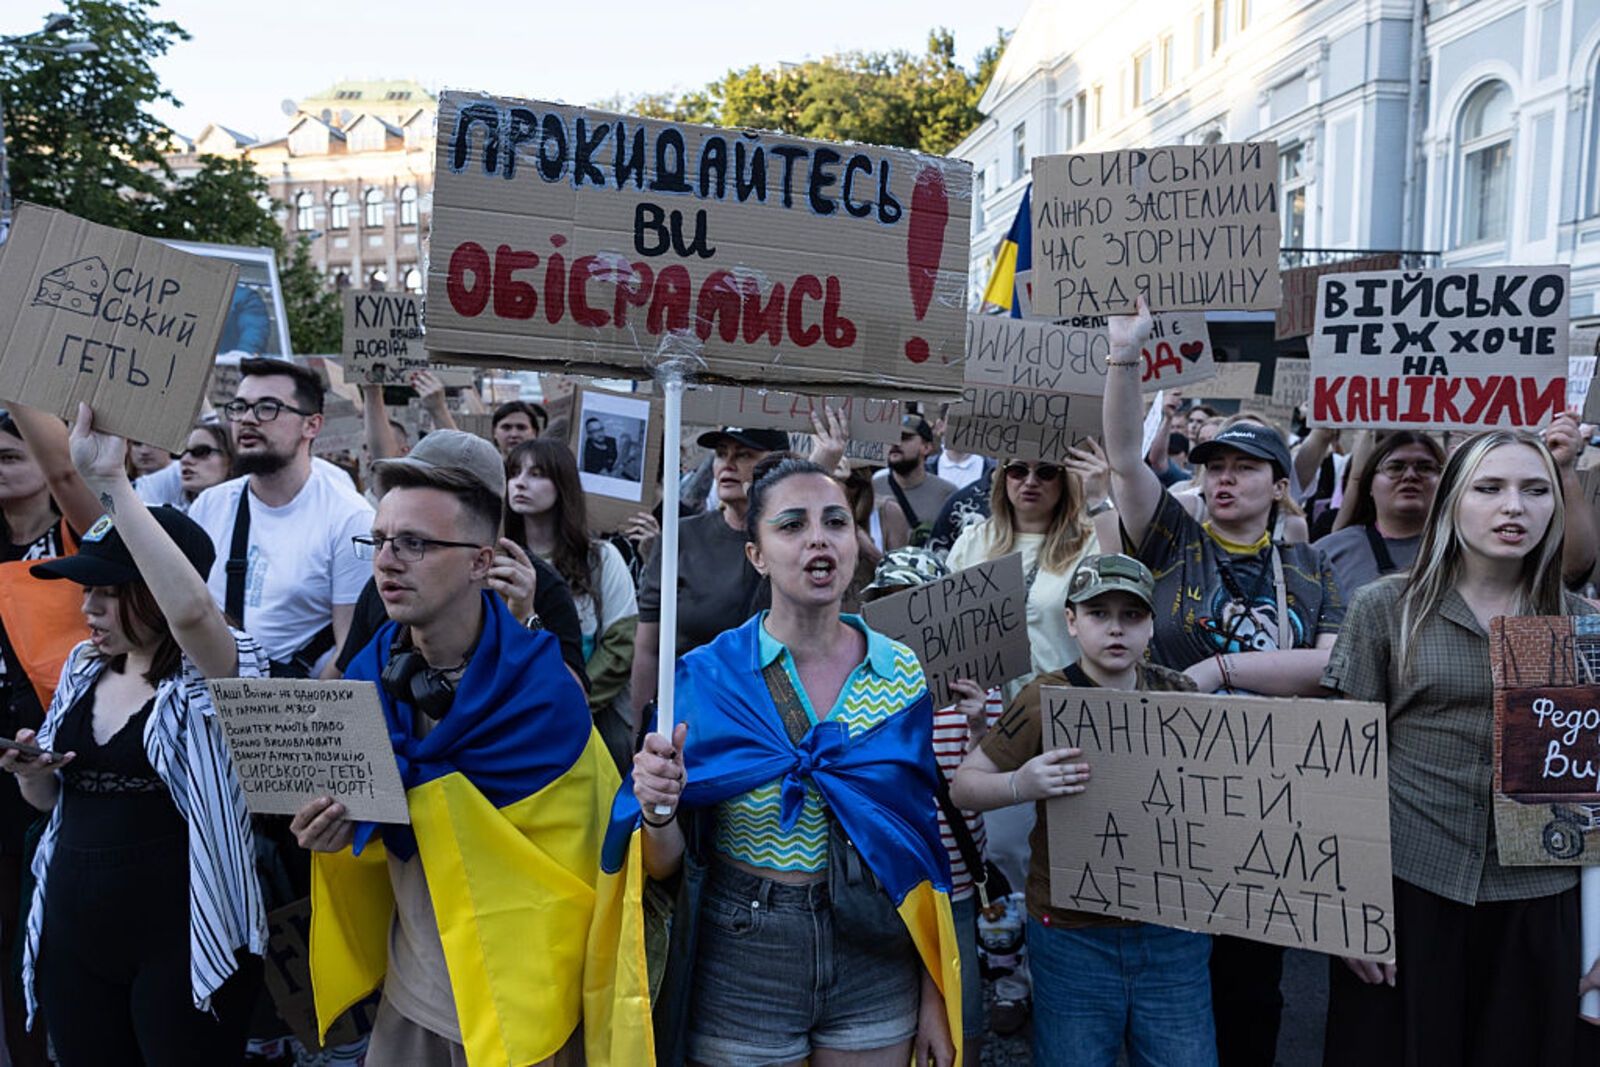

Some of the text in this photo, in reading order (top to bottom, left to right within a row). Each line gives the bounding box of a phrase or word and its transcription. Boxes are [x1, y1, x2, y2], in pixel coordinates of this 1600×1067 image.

[449, 103, 903, 224] ПРОКИДАЙТЕСЬ
[1067, 142, 1262, 187] СИРСЬКИЙ
[1124, 181, 1278, 224] ЗАСТЕЛИЛИ
[634, 202, 716, 259] ВИ
[1040, 223, 1263, 273] ЧАС ЗГОРНУТИ
[112, 267, 181, 305] СИР
[354, 294, 426, 328] КУЛУА
[1053, 267, 1269, 317] РАДЯНЩИНУ
[1324, 272, 1564, 318] ВІЙСЬКО
[102, 298, 198, 348] СЬКИЙ
[965, 320, 1110, 376] ОВОРИМ
[1321, 320, 1557, 355] ТЕЖ ХОЧЕ
[1402, 355, 1449, 376] НА
[1313, 375, 1567, 426] КАНІКУЛИ
[907, 564, 1001, 625] СТРАХ
[921, 596, 1020, 664] ВИГРАЄ
[930, 650, 1005, 706] ІЙНИ
[1049, 697, 1379, 779] КАНІКУЛИ ДЛЯ
[1094, 812, 1342, 886] А НЕ ДЛЯ
[1070, 862, 1392, 955] ДЕПУТАТІВ
